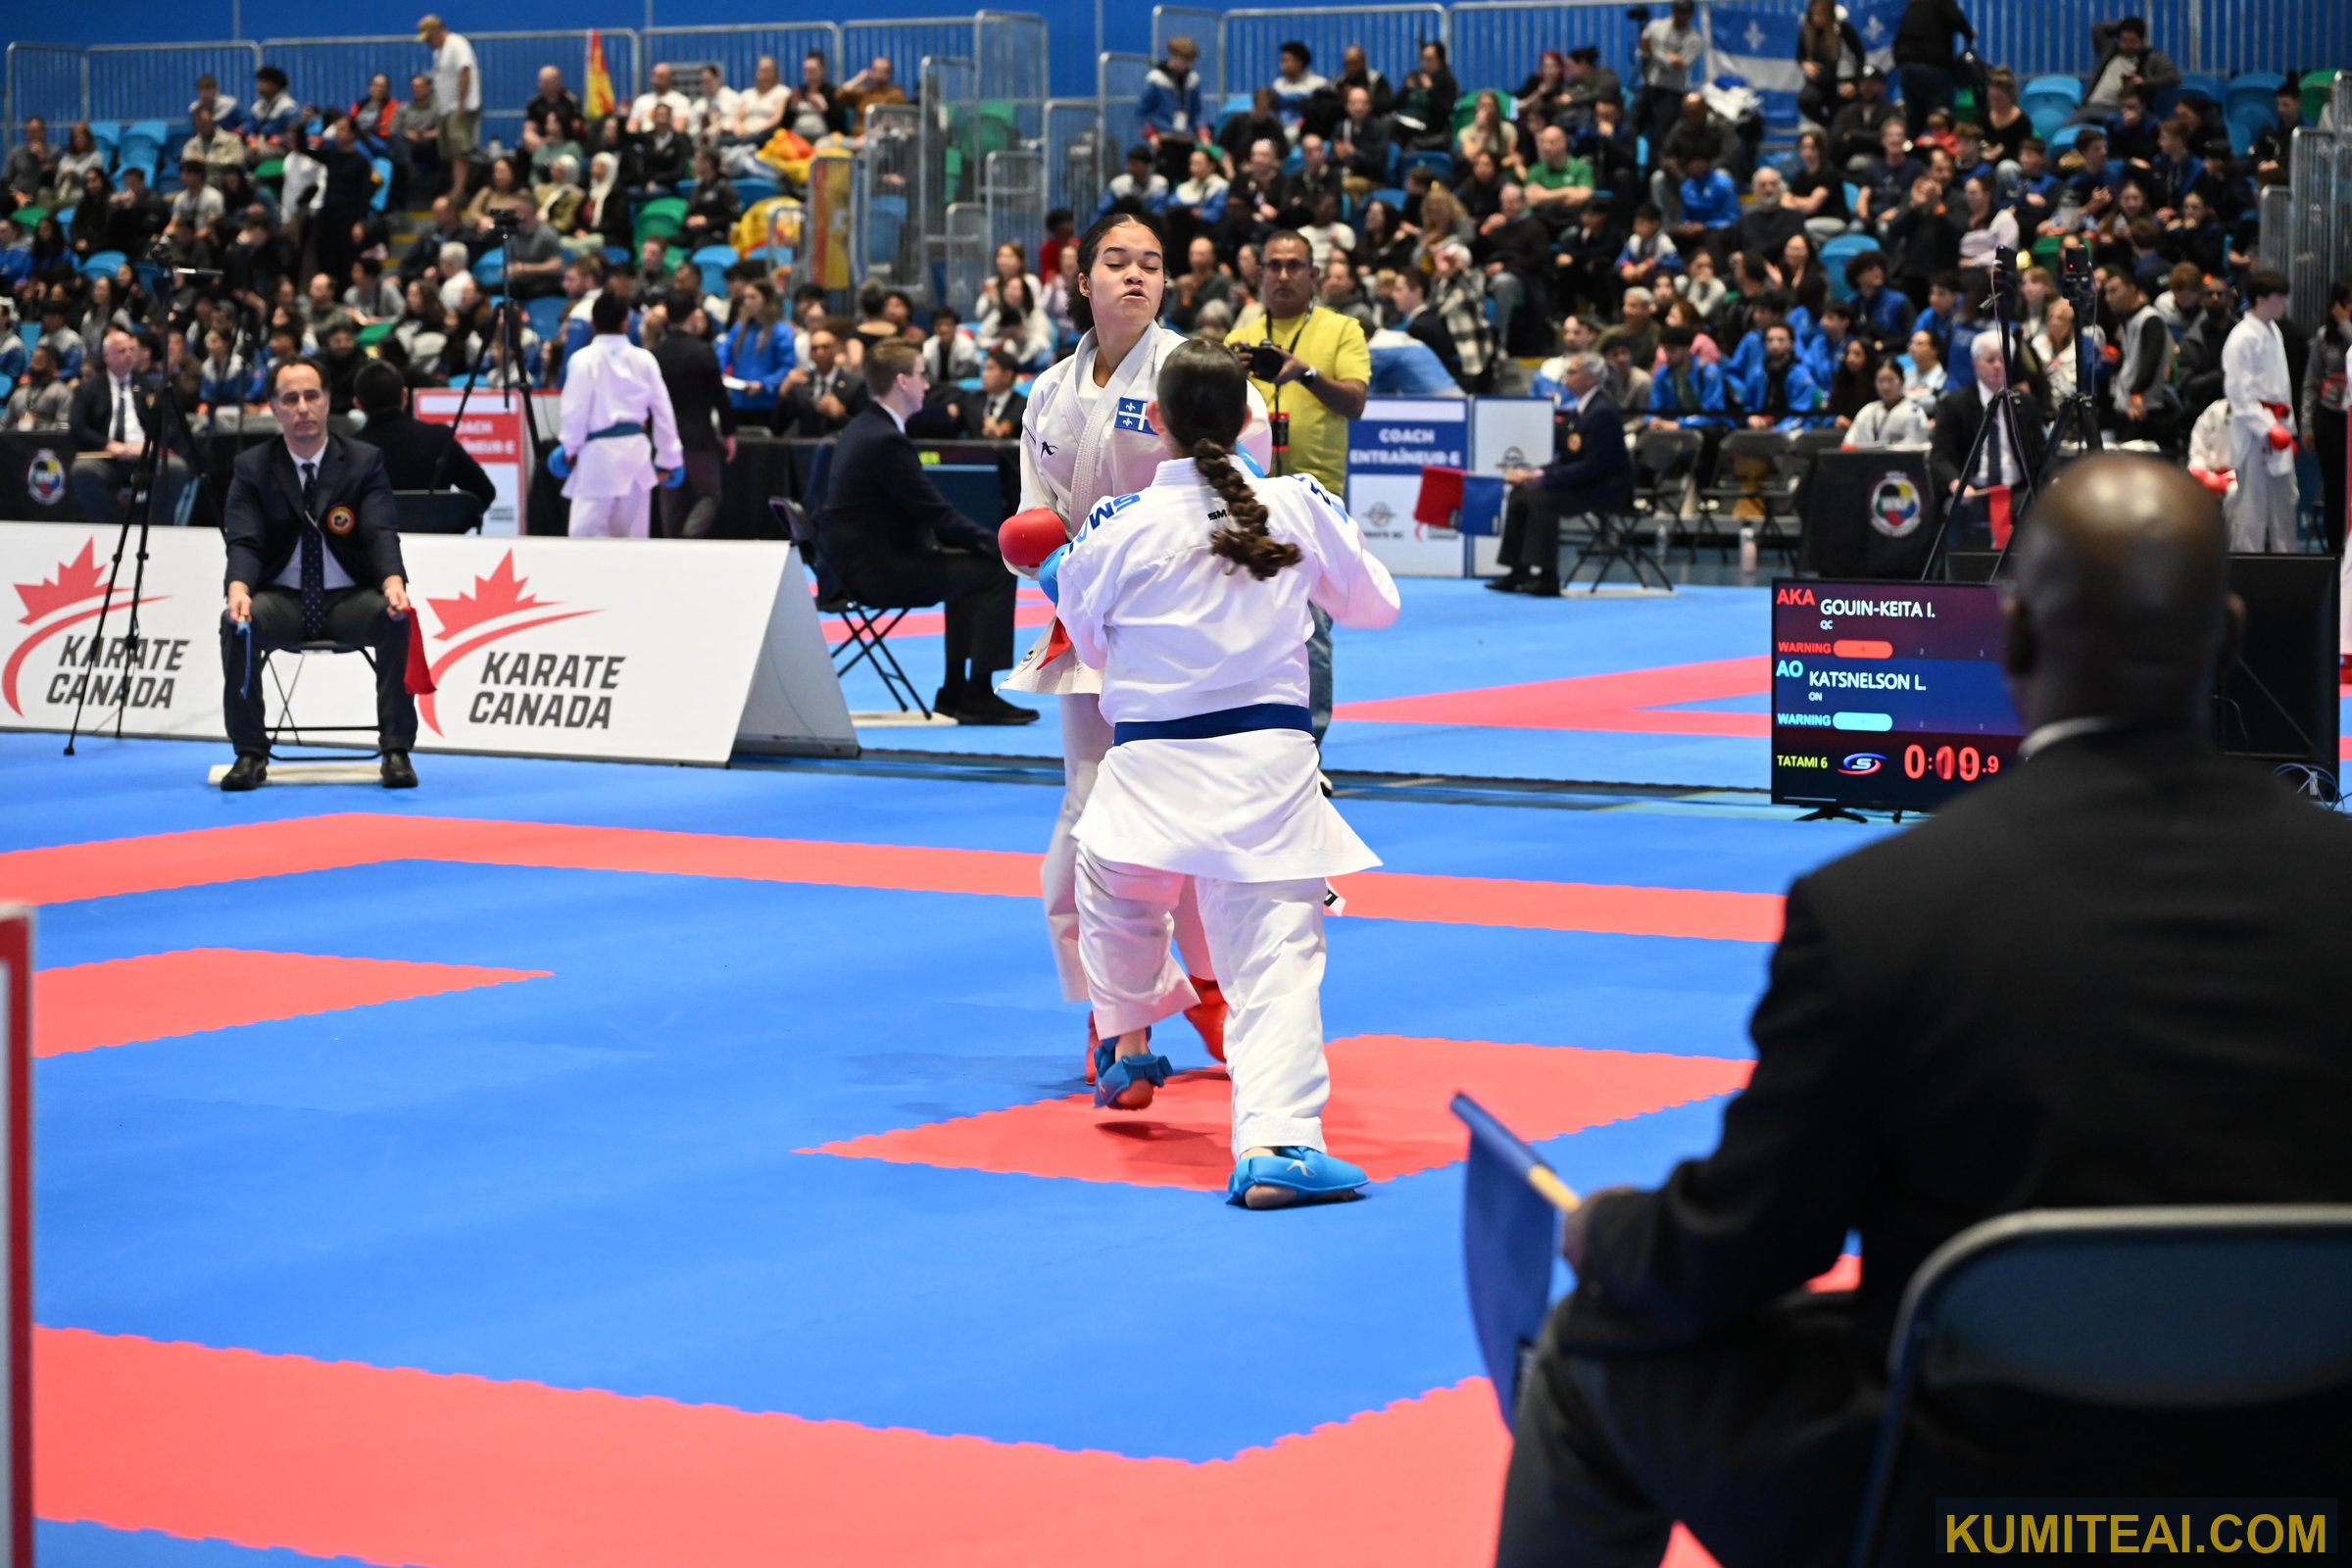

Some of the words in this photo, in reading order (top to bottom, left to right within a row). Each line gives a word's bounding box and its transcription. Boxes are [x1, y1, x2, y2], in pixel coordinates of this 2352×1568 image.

[1378, 428, 1436, 443] COACH
[1207, 509, 1228, 520] SM
[1776, 588, 1815, 606] AKA
[1820, 598, 1924, 618] GOUIN-KEITA
[1927, 602, 1936, 618] I.
[1820, 619, 1833, 630] QC
[58, 635, 190, 671] KARATE
[1778, 641, 1832, 655] WARNING
[480, 652, 626, 689] KARATE
[1776, 660, 1804, 678] AO
[1809, 670, 1910, 691] KATSNELSON
[1915, 674, 1927, 691] L.
[46, 673, 175, 709] CANADA
[1808, 692, 1823, 702] ON
[468, 691, 612, 729] CANADA
[1777, 713, 1832, 727] WARNING
[1777, 755, 1818, 768] TATAMI
[1821, 757, 1829, 769] 6
